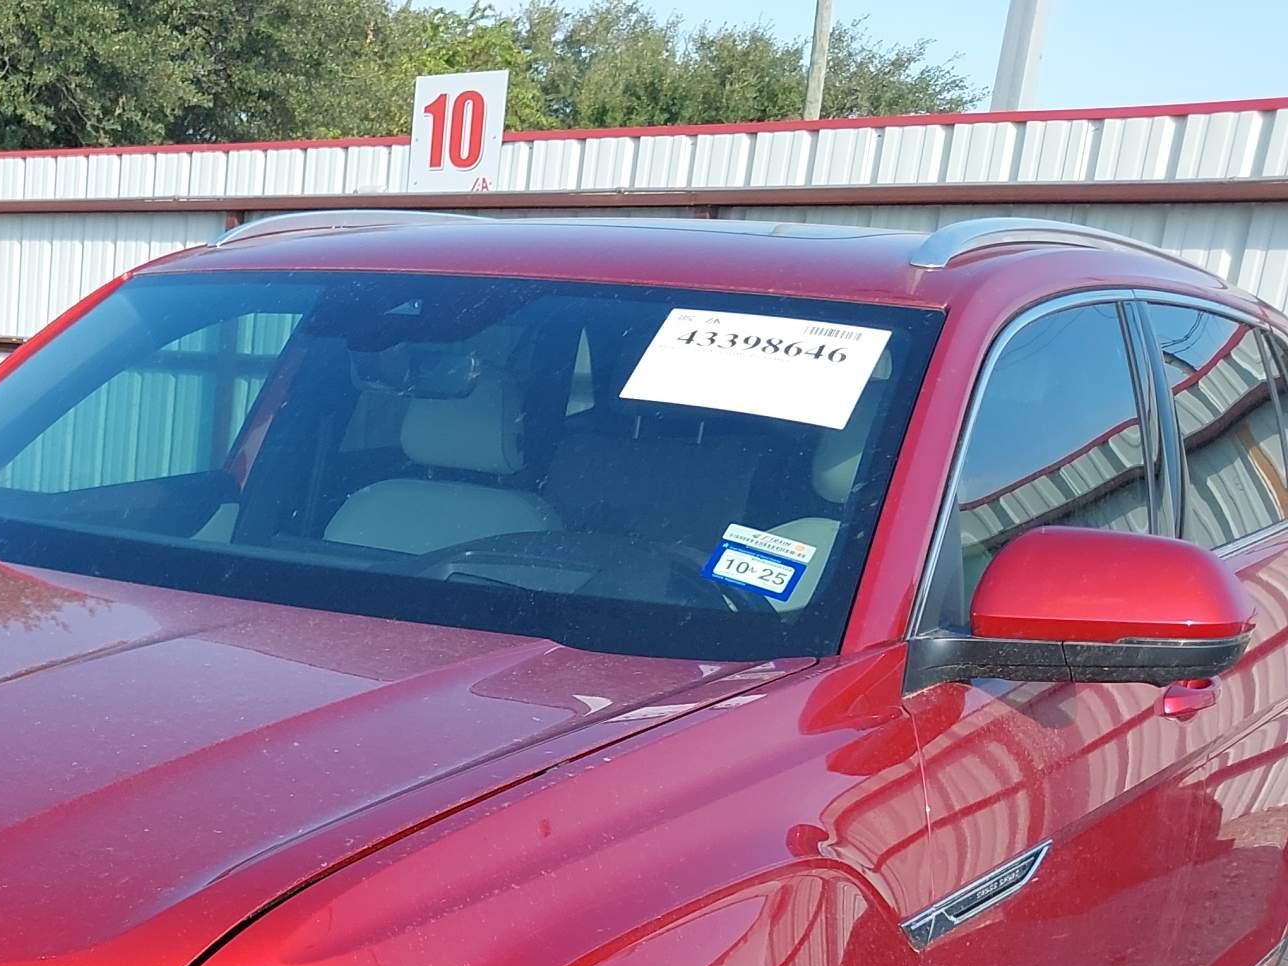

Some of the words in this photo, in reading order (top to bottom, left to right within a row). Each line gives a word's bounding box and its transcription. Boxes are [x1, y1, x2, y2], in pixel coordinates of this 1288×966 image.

[423, 90, 486, 170] 10
[677, 330, 849, 364] 43398646
[725, 558, 750, 575] 10
[757, 568, 789, 586] 25
